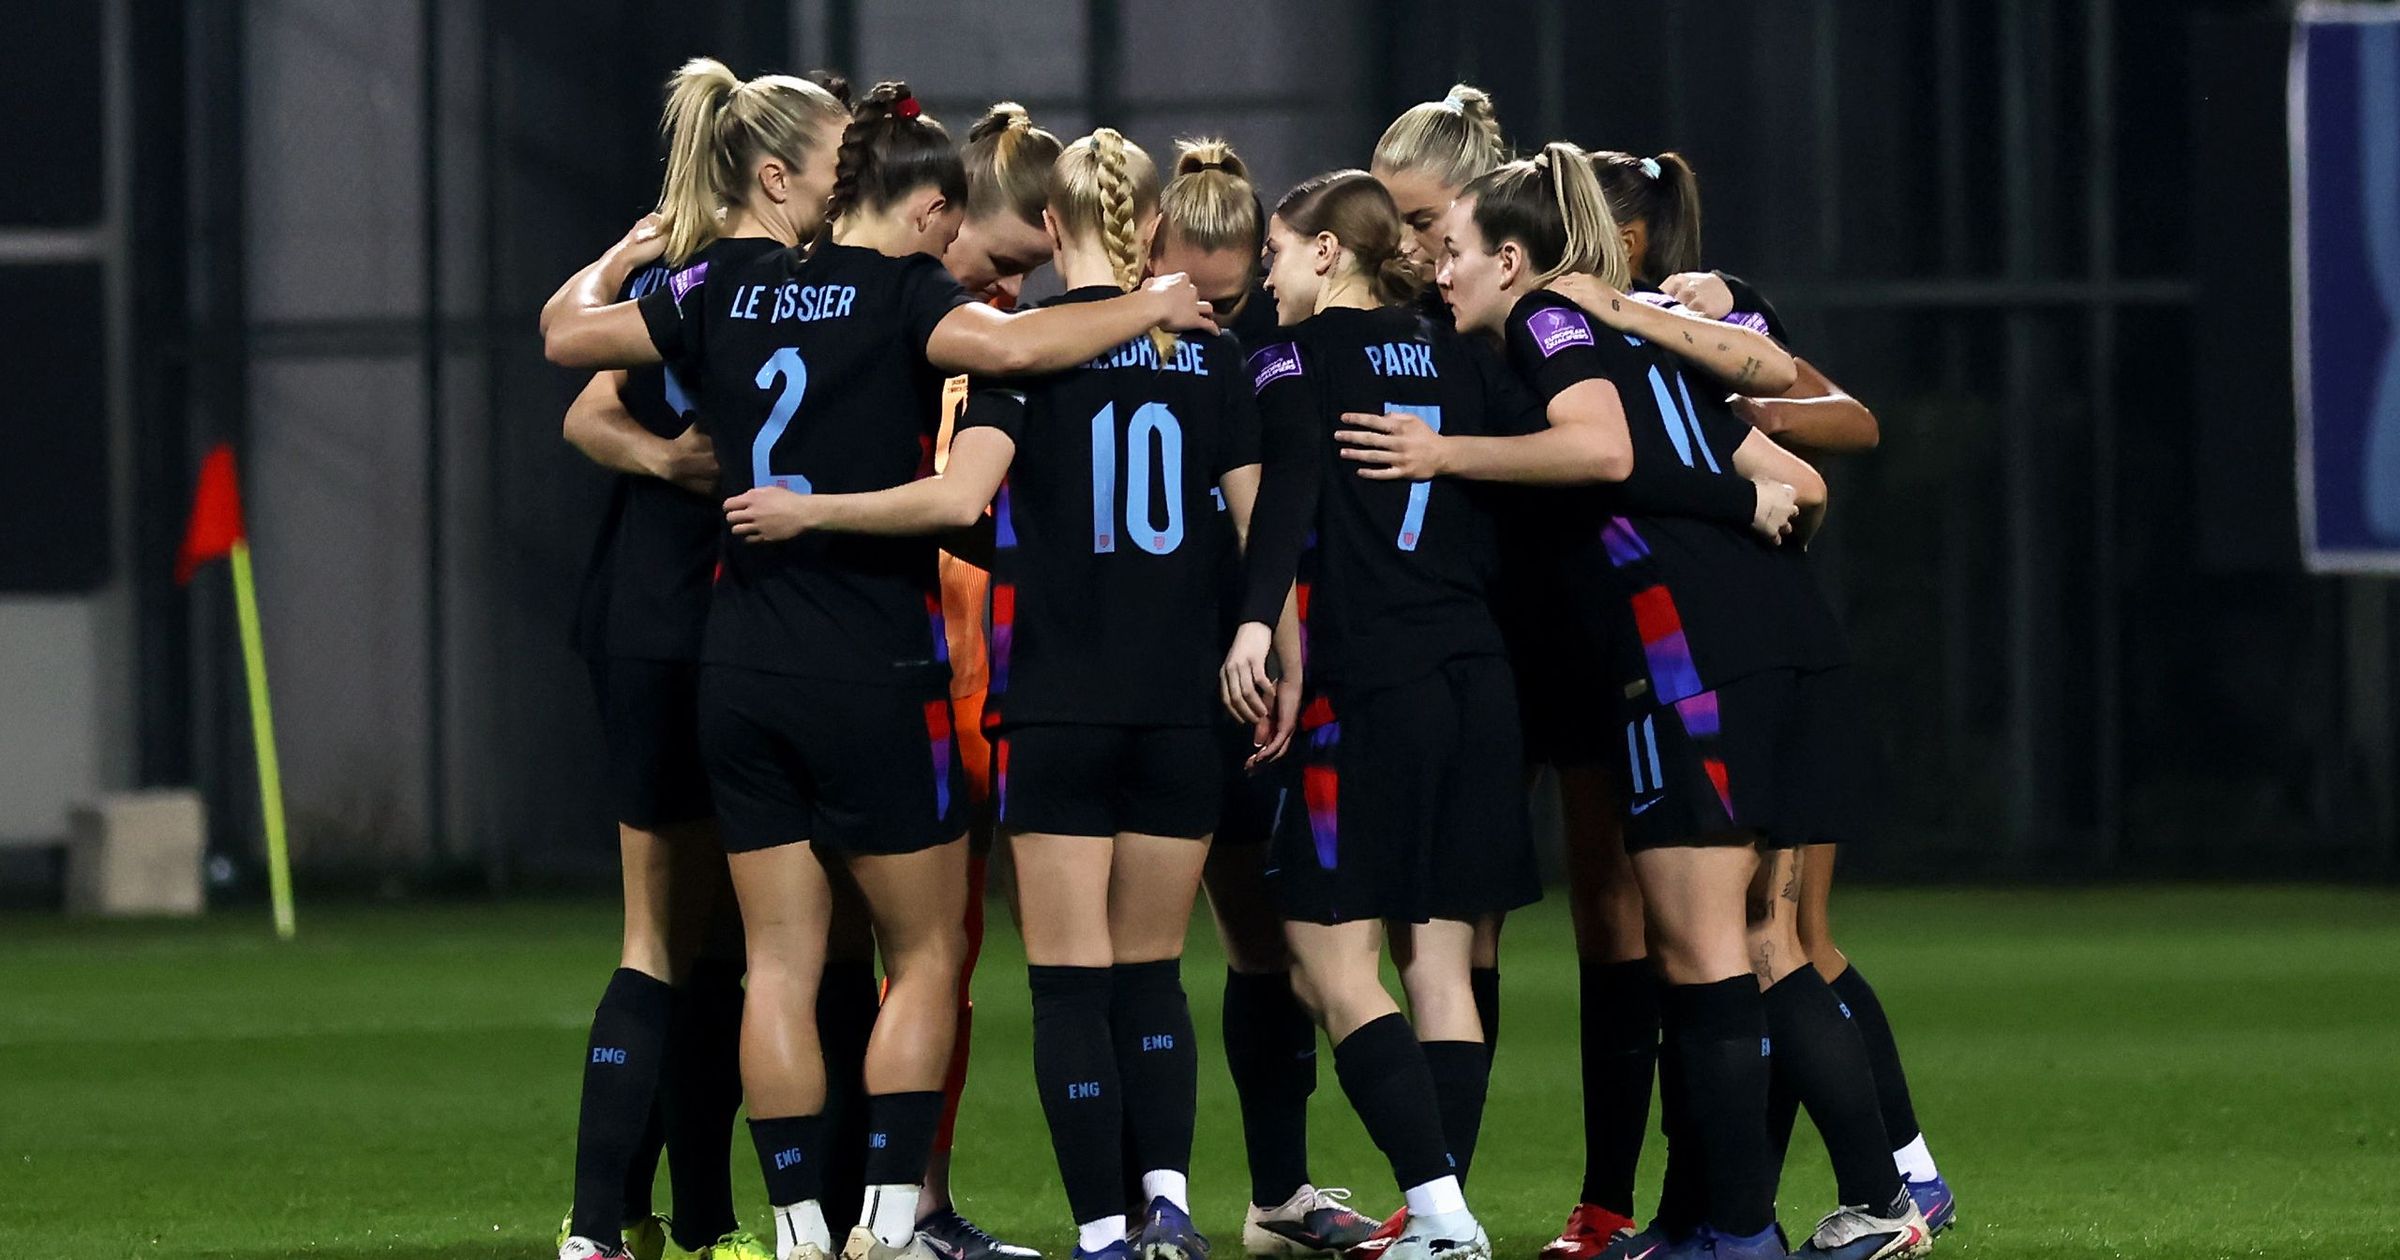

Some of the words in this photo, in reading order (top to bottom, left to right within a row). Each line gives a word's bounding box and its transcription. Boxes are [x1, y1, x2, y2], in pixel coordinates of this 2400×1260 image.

[730, 285, 766, 319] LE
[770, 283, 856, 324] TSSIER
[1363, 342, 1439, 378] PARK
[752, 346, 812, 494] 2
[1647, 364, 1722, 475] 11
[1091, 400, 1185, 555] 10
[1384, 402, 1440, 552] 7
[1626, 713, 1663, 793] 11
[592, 1047, 627, 1065] ENG
[1142, 1034, 1174, 1052] ENG
[1068, 1082, 1100, 1100] ENG
[774, 1147, 802, 1171] ENG
